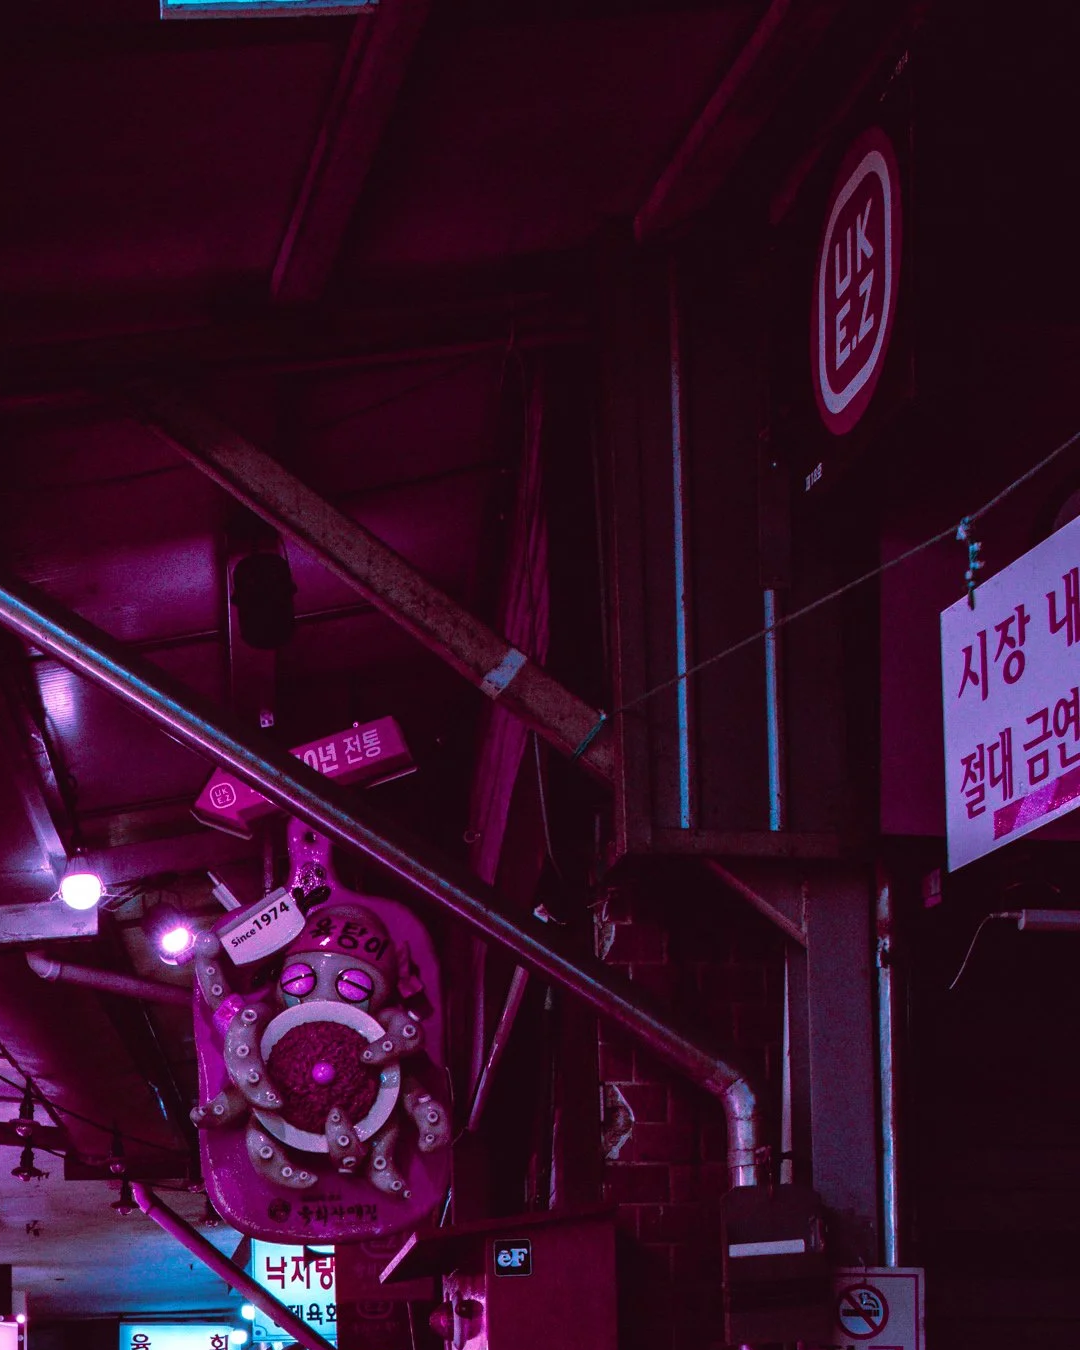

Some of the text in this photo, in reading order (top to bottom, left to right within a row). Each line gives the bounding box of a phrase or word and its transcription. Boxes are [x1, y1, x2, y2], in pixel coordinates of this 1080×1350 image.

[957, 567, 1080, 701] 시장 내
[294, 728, 381, 774] 0년 전통
[960, 727, 1013, 820] 절대
[231, 901, 290, 947] Since 1974
